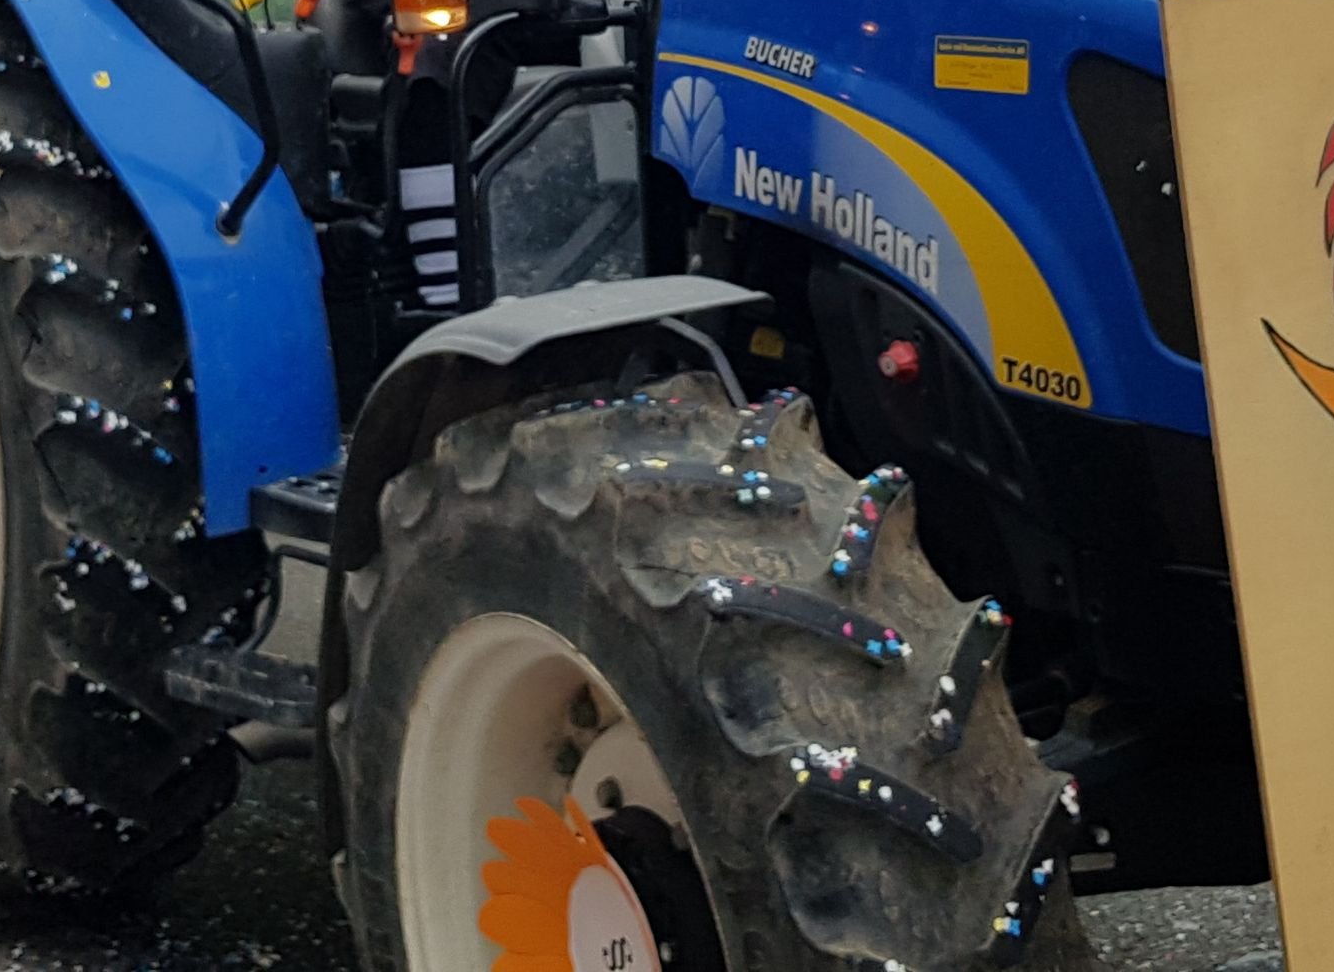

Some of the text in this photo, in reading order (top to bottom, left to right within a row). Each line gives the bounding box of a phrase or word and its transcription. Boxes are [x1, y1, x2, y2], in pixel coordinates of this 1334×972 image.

[744, 35, 816, 78] BUCHER
[734, 146, 939, 295] New Holland
[1002, 356, 1081, 402] T4030
